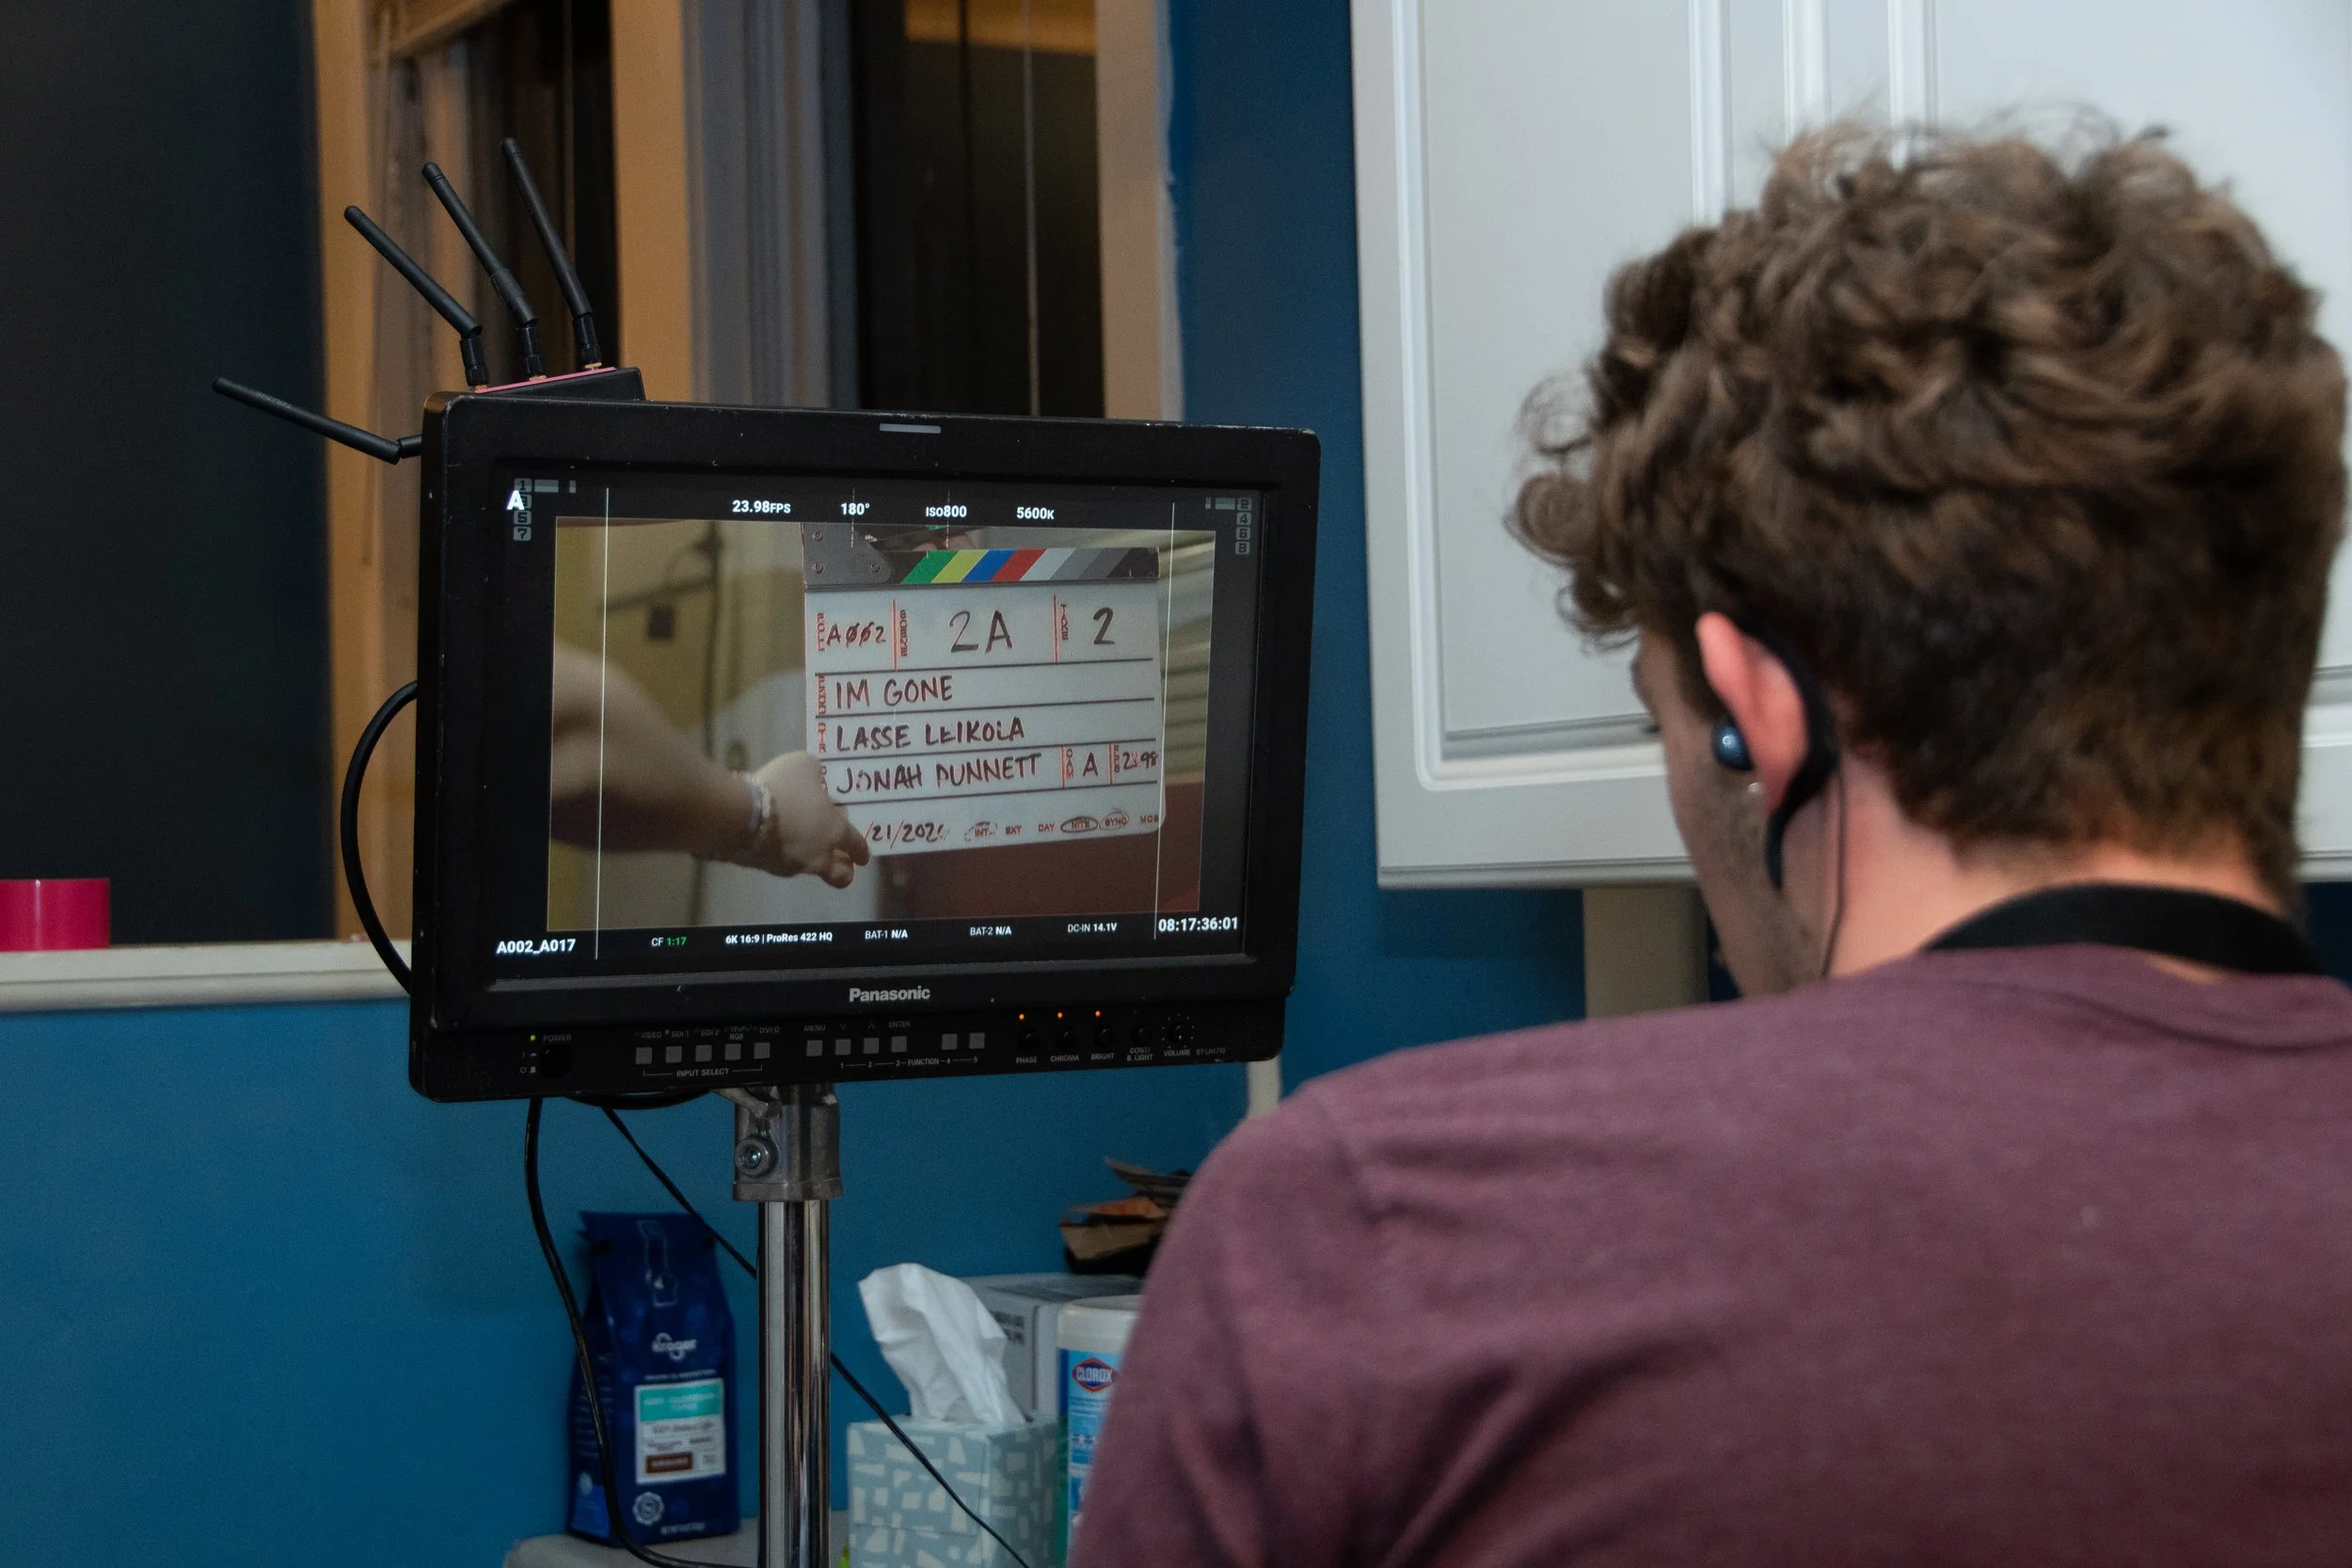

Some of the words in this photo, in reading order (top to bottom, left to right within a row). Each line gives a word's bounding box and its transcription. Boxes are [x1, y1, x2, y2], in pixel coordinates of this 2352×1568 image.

[507, 489, 525, 510] A
[733, 499, 791, 514] 23.98FPS
[926, 505, 967, 517] ISO800
[1016, 506, 1055, 519] 5600K
[1060, 604, 1070, 641] TAKE
[1092, 607, 1116, 645] 2
[836, 679, 870, 709] IM
[883, 675, 953, 706] GONE
[836, 724, 912, 752] LASSE
[925, 717, 1025, 746] LEIKOLA
[1066, 749, 1075, 780] CAM
[1082, 752, 1099, 777] A
[836, 763, 923, 794] JONAH
[1038, 823, 1055, 832] DAY
[1071, 819, 1090, 830] NITE
[1068, 923, 1091, 933] DC-IN
[1093, 923, 1118, 932] 14.1V
[1158, 916, 1239, 931] 08:17:36:01
[725, 934, 739, 944] 6K
[740, 934, 759, 944] 16:9
[767, 932, 799, 943] ProRes
[801, 931, 818, 942] 422
[819, 931, 834, 942] HQ
[865, 929, 888, 940] BAT-1
[891, 929, 909, 939] N/A
[970, 926, 993, 936] BAT-2
[995, 926, 1012, 935] N/A
[496, 939, 577, 956] A002_A017
[651, 937, 664, 947] CF
[666, 936, 688, 946] 1:17
[850, 985, 931, 1003] Panasonic
[803, 1023, 826, 1032] MENU
[889, 1020, 911, 1028] ENTER
[641, 1031, 662, 1039] VIDEO
[1050, 1053, 1080, 1063] CHROMA
[1090, 1052, 1115, 1061] BRIGHT
[1135, 1053, 1153, 1062] LIGHT
[1163, 1048, 1191, 1057] VOLUME
[908, 1057, 940, 1066] FUNCTION
[1016, 1055, 1038, 1064] PHASE
[676, 1069, 700, 1077] INPUT
[702, 1068, 729, 1076] SELECT
[1076, 1366, 1113, 1383] CLOROX
